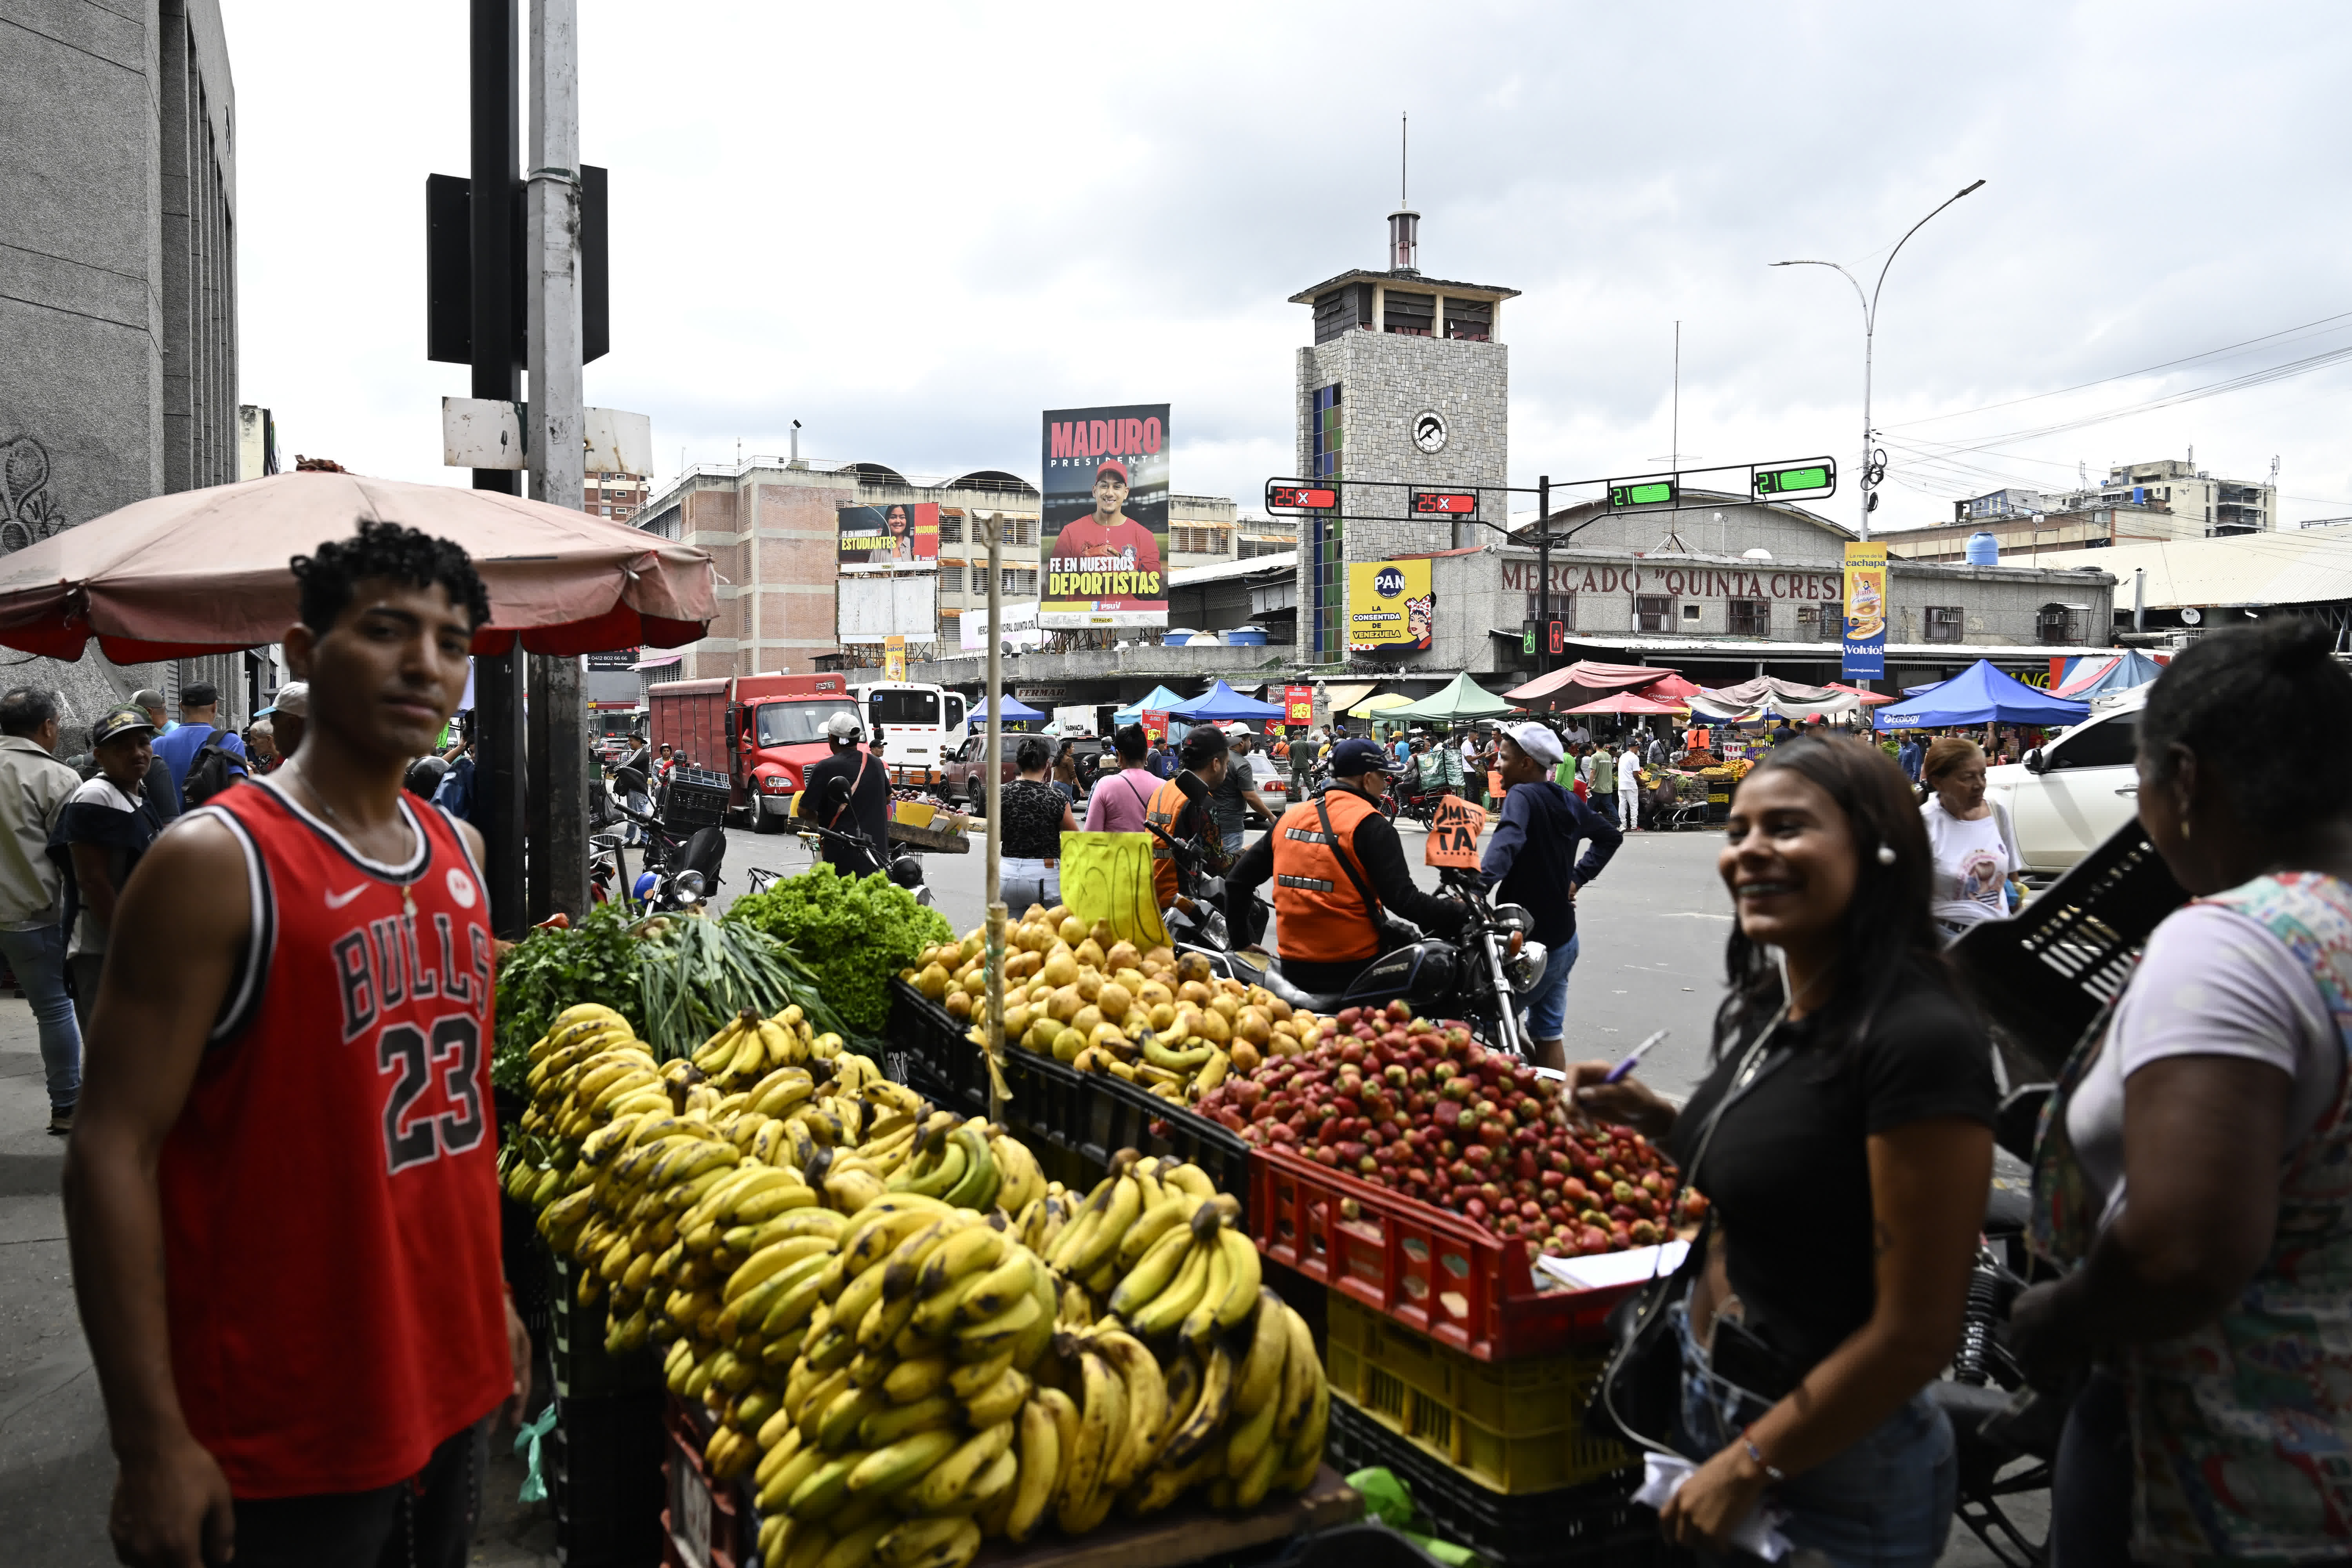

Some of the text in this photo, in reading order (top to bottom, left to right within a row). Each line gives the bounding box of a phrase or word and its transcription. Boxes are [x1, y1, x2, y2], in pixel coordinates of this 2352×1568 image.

[1051, 417, 1161, 458] MADURO
[1760, 472, 1780, 493] 21
[1275, 488, 1294, 506] 25
[1418, 494, 1436, 511] 25
[1613, 487, 1631, 506] 21
[915, 525, 937, 534] MADURO
[842, 536, 897, 550] ESTUDIANTES
[1050, 556, 1134, 572] FE EN NUESTROS
[1846, 559, 1886, 568] cachapa
[1049, 571, 1160, 595] DEPORTISTAS
[1501, 563, 1641, 593] MERCADO
[1771, 573, 1844, 600] CRES
[1353, 613, 1401, 621] CONSENTIDA
[1014, 621, 1027, 632] QUINTA
[1353, 630, 1401, 639] VENEZUELA
[1843, 645, 1883, 656] ¡Volvió!
[1891, 714, 1920, 724] Ecology
[332, 913, 490, 1044] BULLS
[377, 1014, 485, 1175] 23
